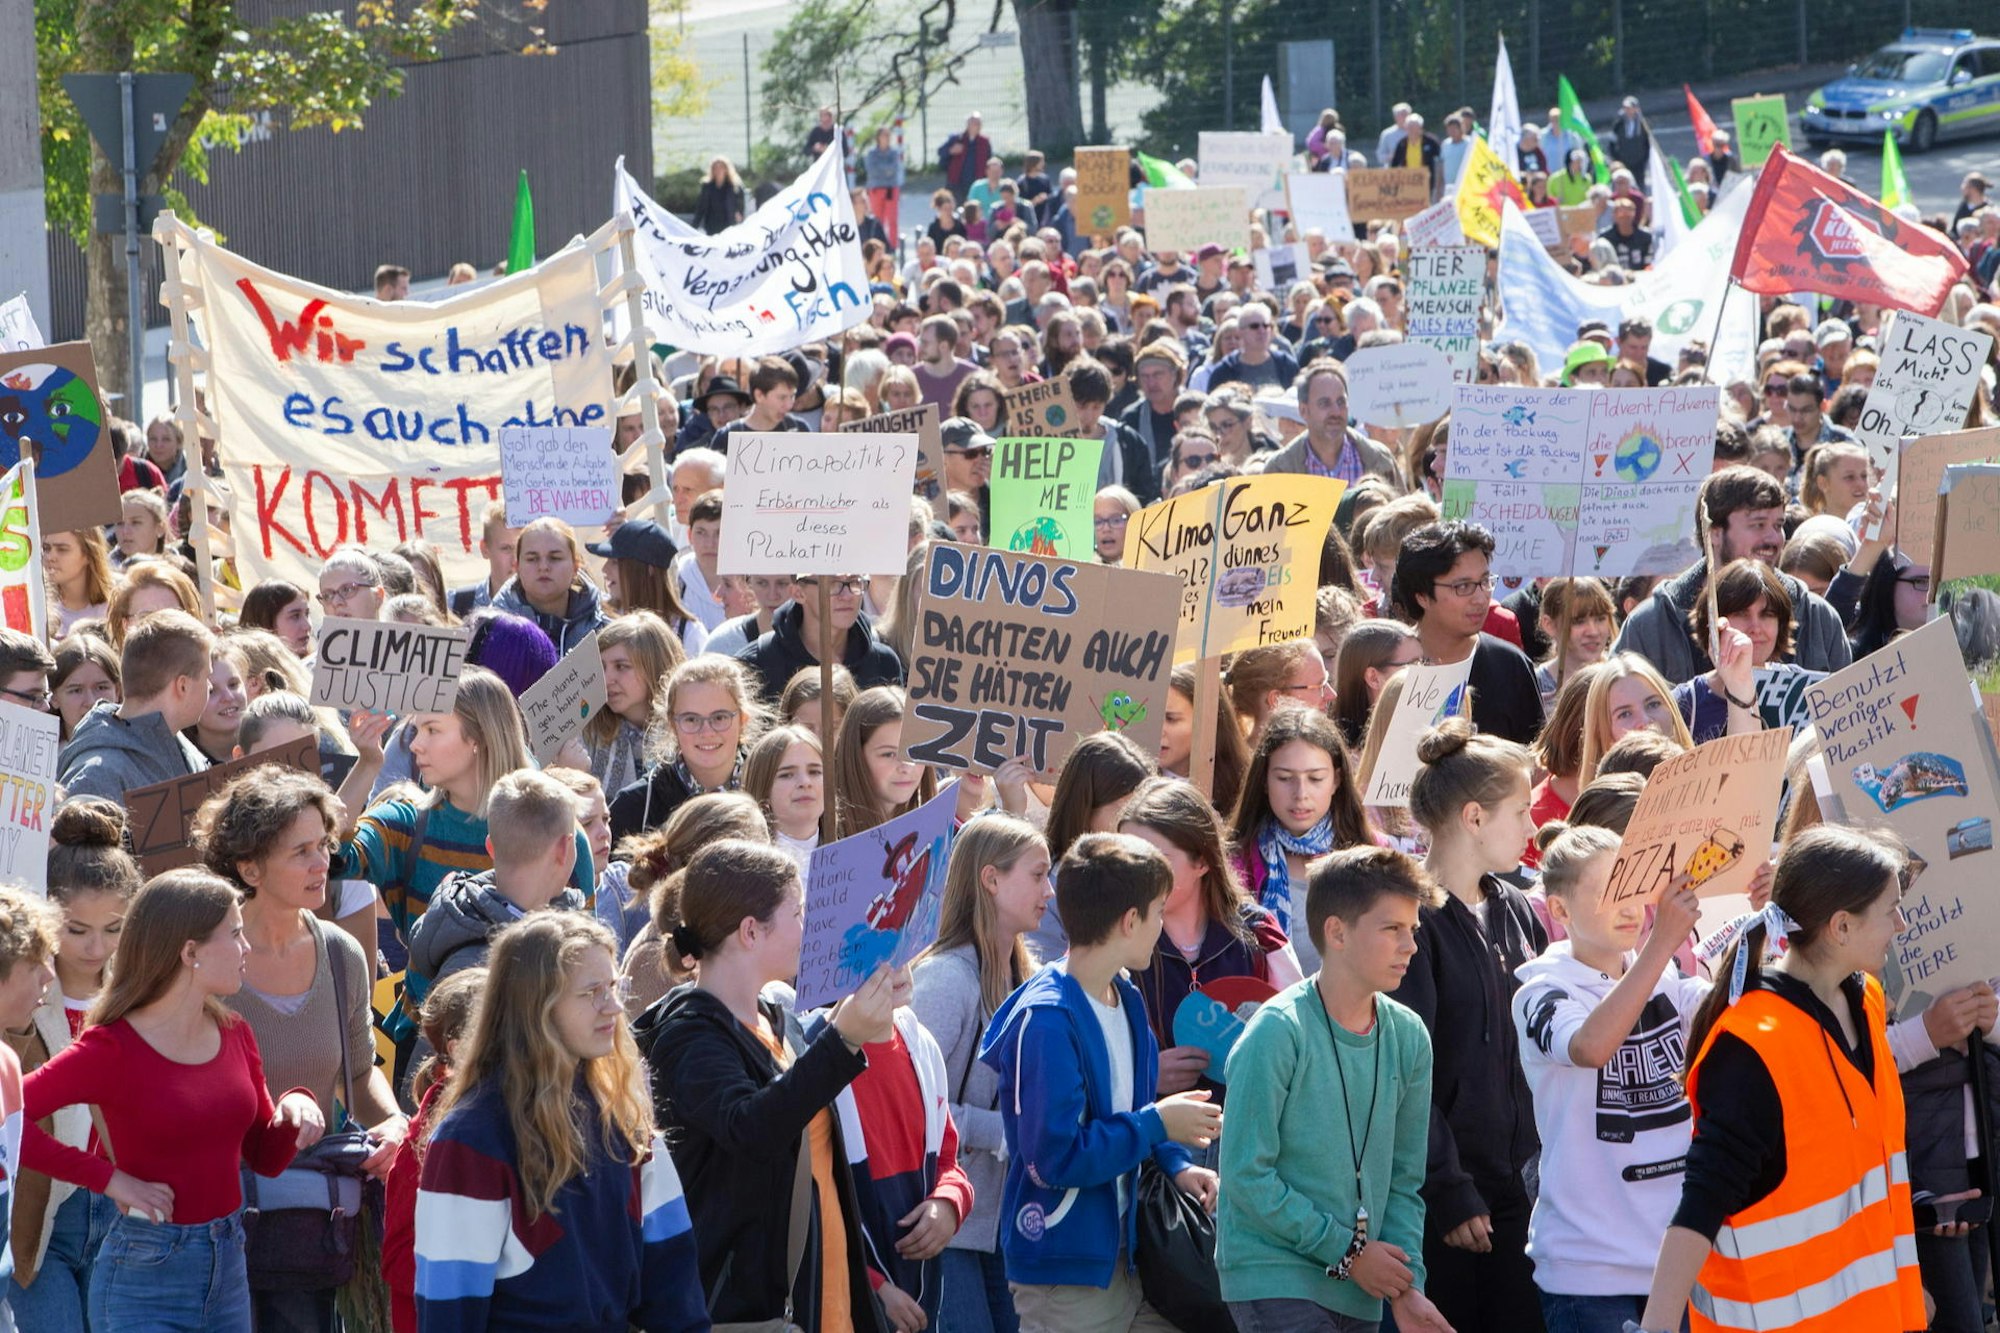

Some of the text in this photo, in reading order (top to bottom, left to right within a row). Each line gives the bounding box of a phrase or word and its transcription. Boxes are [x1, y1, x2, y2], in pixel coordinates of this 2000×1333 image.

[1412, 256, 1464, 276] TIER
[1413, 280, 1478, 296] PFLANZE
[236, 277, 366, 364] Wir
[1410, 318, 1441, 334] ALLES
[379, 322, 589, 375] schaffen
[1876, 372, 1893, 390] ich
[1895, 357, 1949, 381] Mich!
[1006, 382, 1060, 409] THERE
[1459, 386, 1577, 406] Früher war der
[283, 391, 355, 436] es
[361, 402, 489, 445] auch
[1017, 408, 1034, 426] IS
[1474, 423, 1498, 438] der
[502, 430, 588, 461] Gott gab den
[1452, 439, 1490, 457] Heute
[1496, 442, 1512, 457] ist
[1589, 428, 1712, 452] die brennt
[1000, 442, 1076, 480] HELP
[871, 501, 890, 509] als
[1039, 483, 1070, 511] ME
[1584, 486, 1599, 498] Die
[1604, 485, 1635, 497] Dinos
[1443, 499, 1579, 522] ENTSCHEIDUNGEN
[1602, 517, 1631, 525] haben
[796, 516, 848, 536] dieses
[1135, 483, 1311, 570] Klima Ganz
[1492, 521, 1525, 533] keine
[1224, 542, 1280, 569] dünnes
[928, 544, 1079, 616] DINOS
[1245, 599, 1285, 618] mein
[922, 610, 1170, 682] DACHTEN AUCH
[1258, 619, 1309, 647] Freund!
[321, 629, 466, 679] CLIMATE
[320, 665, 452, 714] JUSTICE
[528, 668, 578, 717] The planet
[910, 656, 1073, 712] SIE HÄTTEN
[1406, 673, 1439, 711] We
[1808, 650, 1906, 721] Benutzt
[538, 714, 557, 735] gets
[556, 689, 581, 714] hotter
[1820, 691, 1896, 740] weniger
[542, 717, 577, 746] my boy
[907, 703, 1065, 773] ZEIT
[1824, 717, 1897, 766] Plastik
[812, 849, 840, 870] the
[1602, 841, 1676, 905] PIZZA
[809, 867, 858, 893] titanic
[806, 887, 849, 914] would
[804, 917, 838, 937] have
[802, 940, 822, 955] no
[1900, 946, 1924, 965] die
[1903, 943, 1958, 985] TIERE
